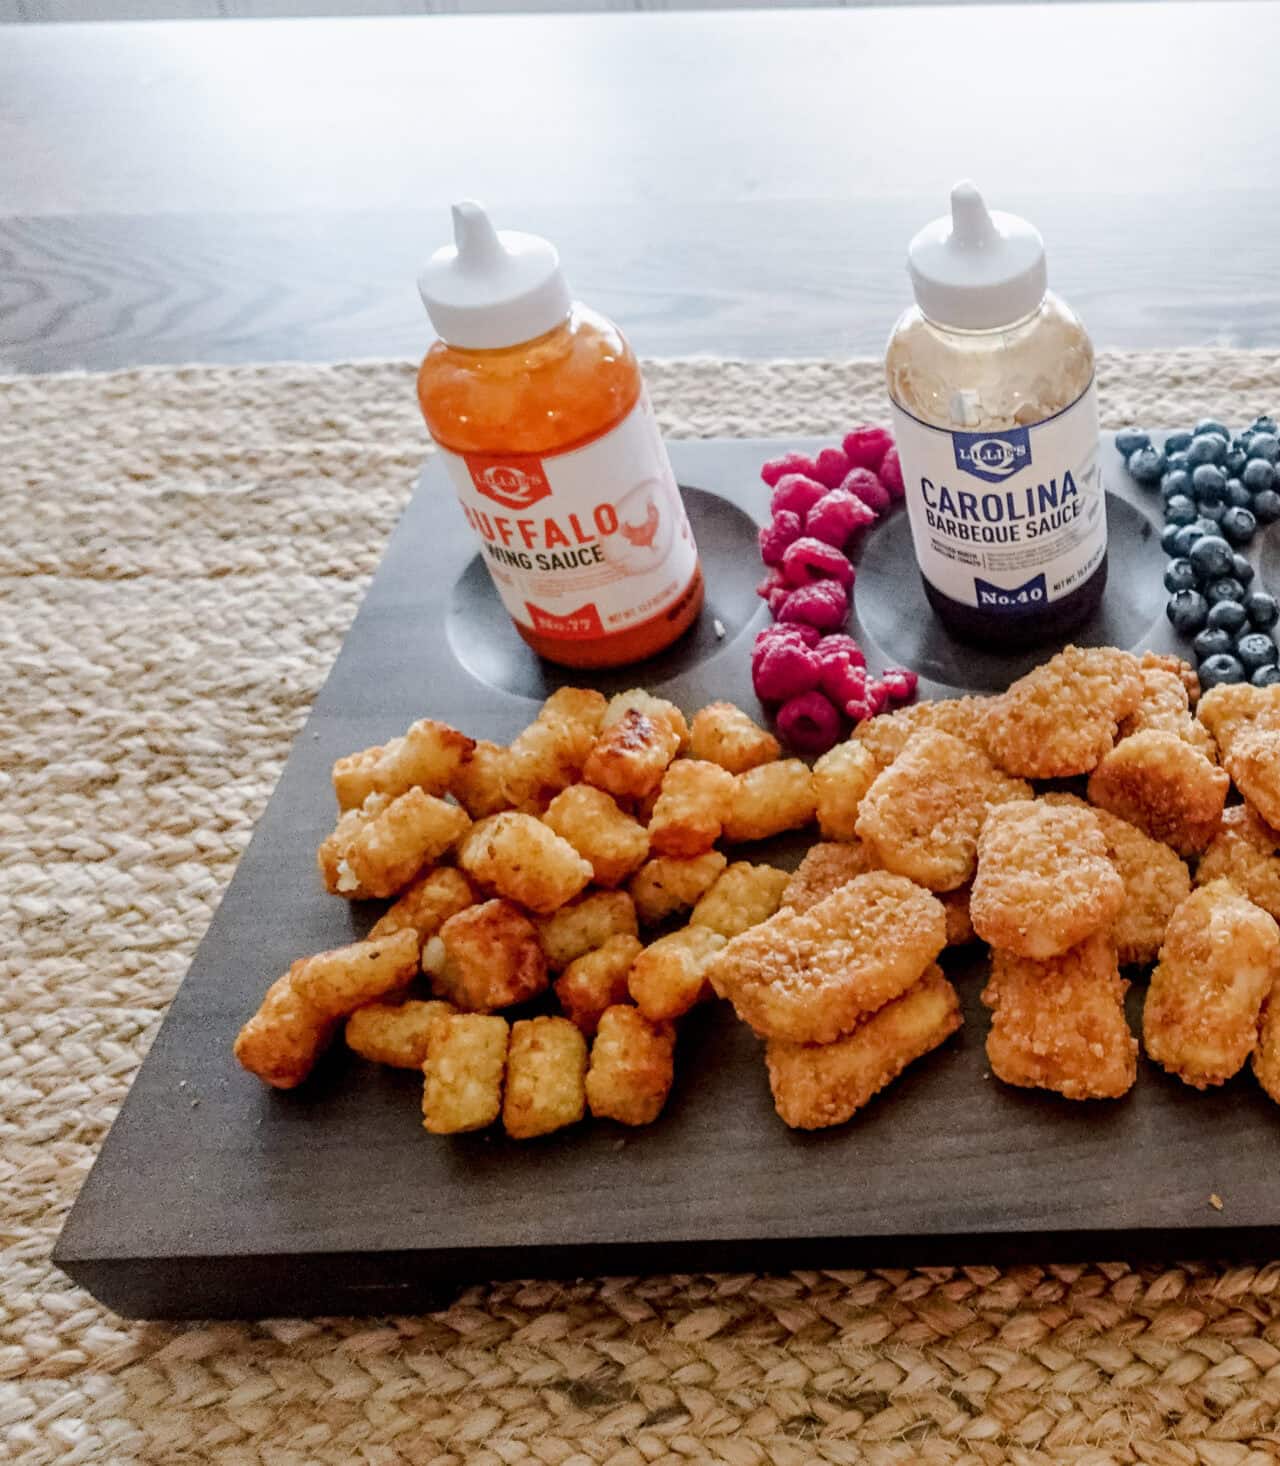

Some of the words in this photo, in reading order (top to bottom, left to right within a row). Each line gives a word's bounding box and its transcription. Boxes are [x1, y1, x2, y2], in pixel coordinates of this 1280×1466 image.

[959, 444, 1026, 460] LILLIE'S
[921, 469, 1078, 523] CAROLINA
[926, 508, 1021, 543] BARBEQUE
[1026, 500, 1081, 539] SAUCE
[484, 542, 532, 570] WING
[535, 544, 605, 571] SAUCE
[980, 587, 1043, 605] No.40
